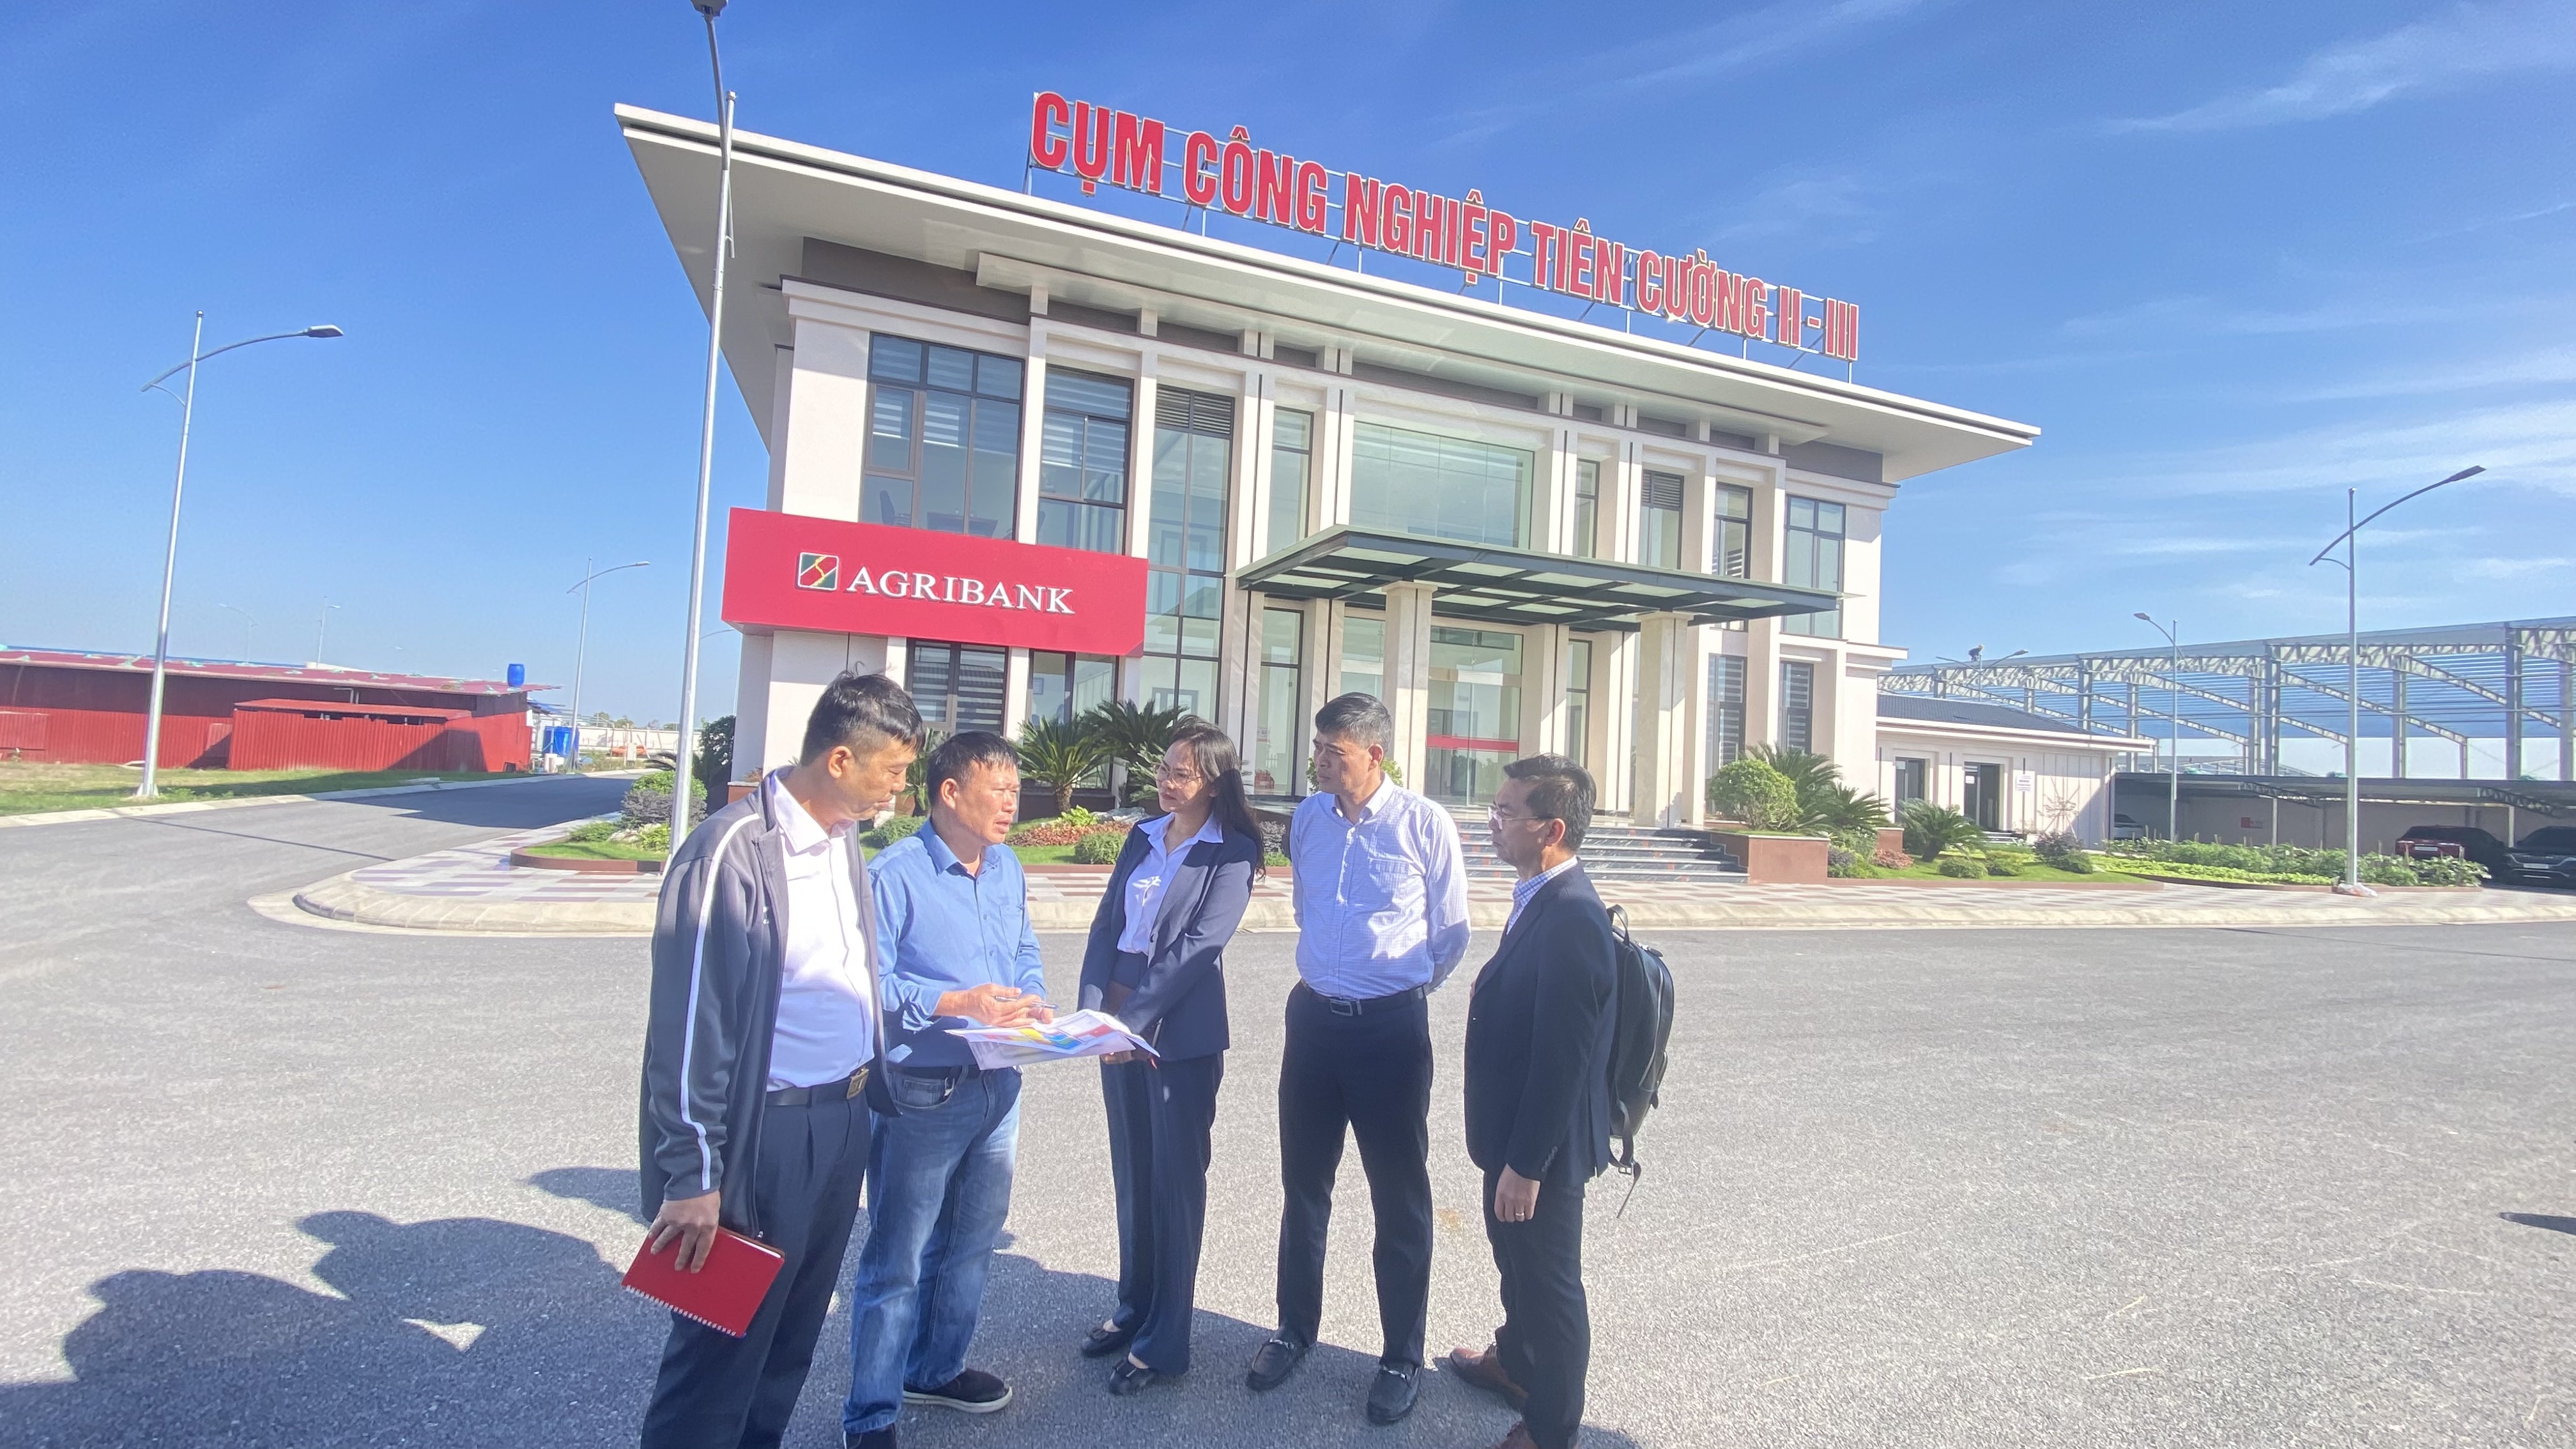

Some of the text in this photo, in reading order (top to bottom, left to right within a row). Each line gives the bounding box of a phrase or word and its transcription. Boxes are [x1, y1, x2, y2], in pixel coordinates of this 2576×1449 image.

[1031, 91, 1165, 196] CỤM
[1184, 125, 1328, 234] CÔNG
[1344, 172, 1517, 286] NGHIỆP
[1531, 217, 1625, 305] TIÊN
[1637, 248, 1767, 339] CƯỜNG
[1778, 286, 1802, 346] II
[1825, 298, 1859, 362] III
[846, 566, 1075, 615] AGRIBANK
